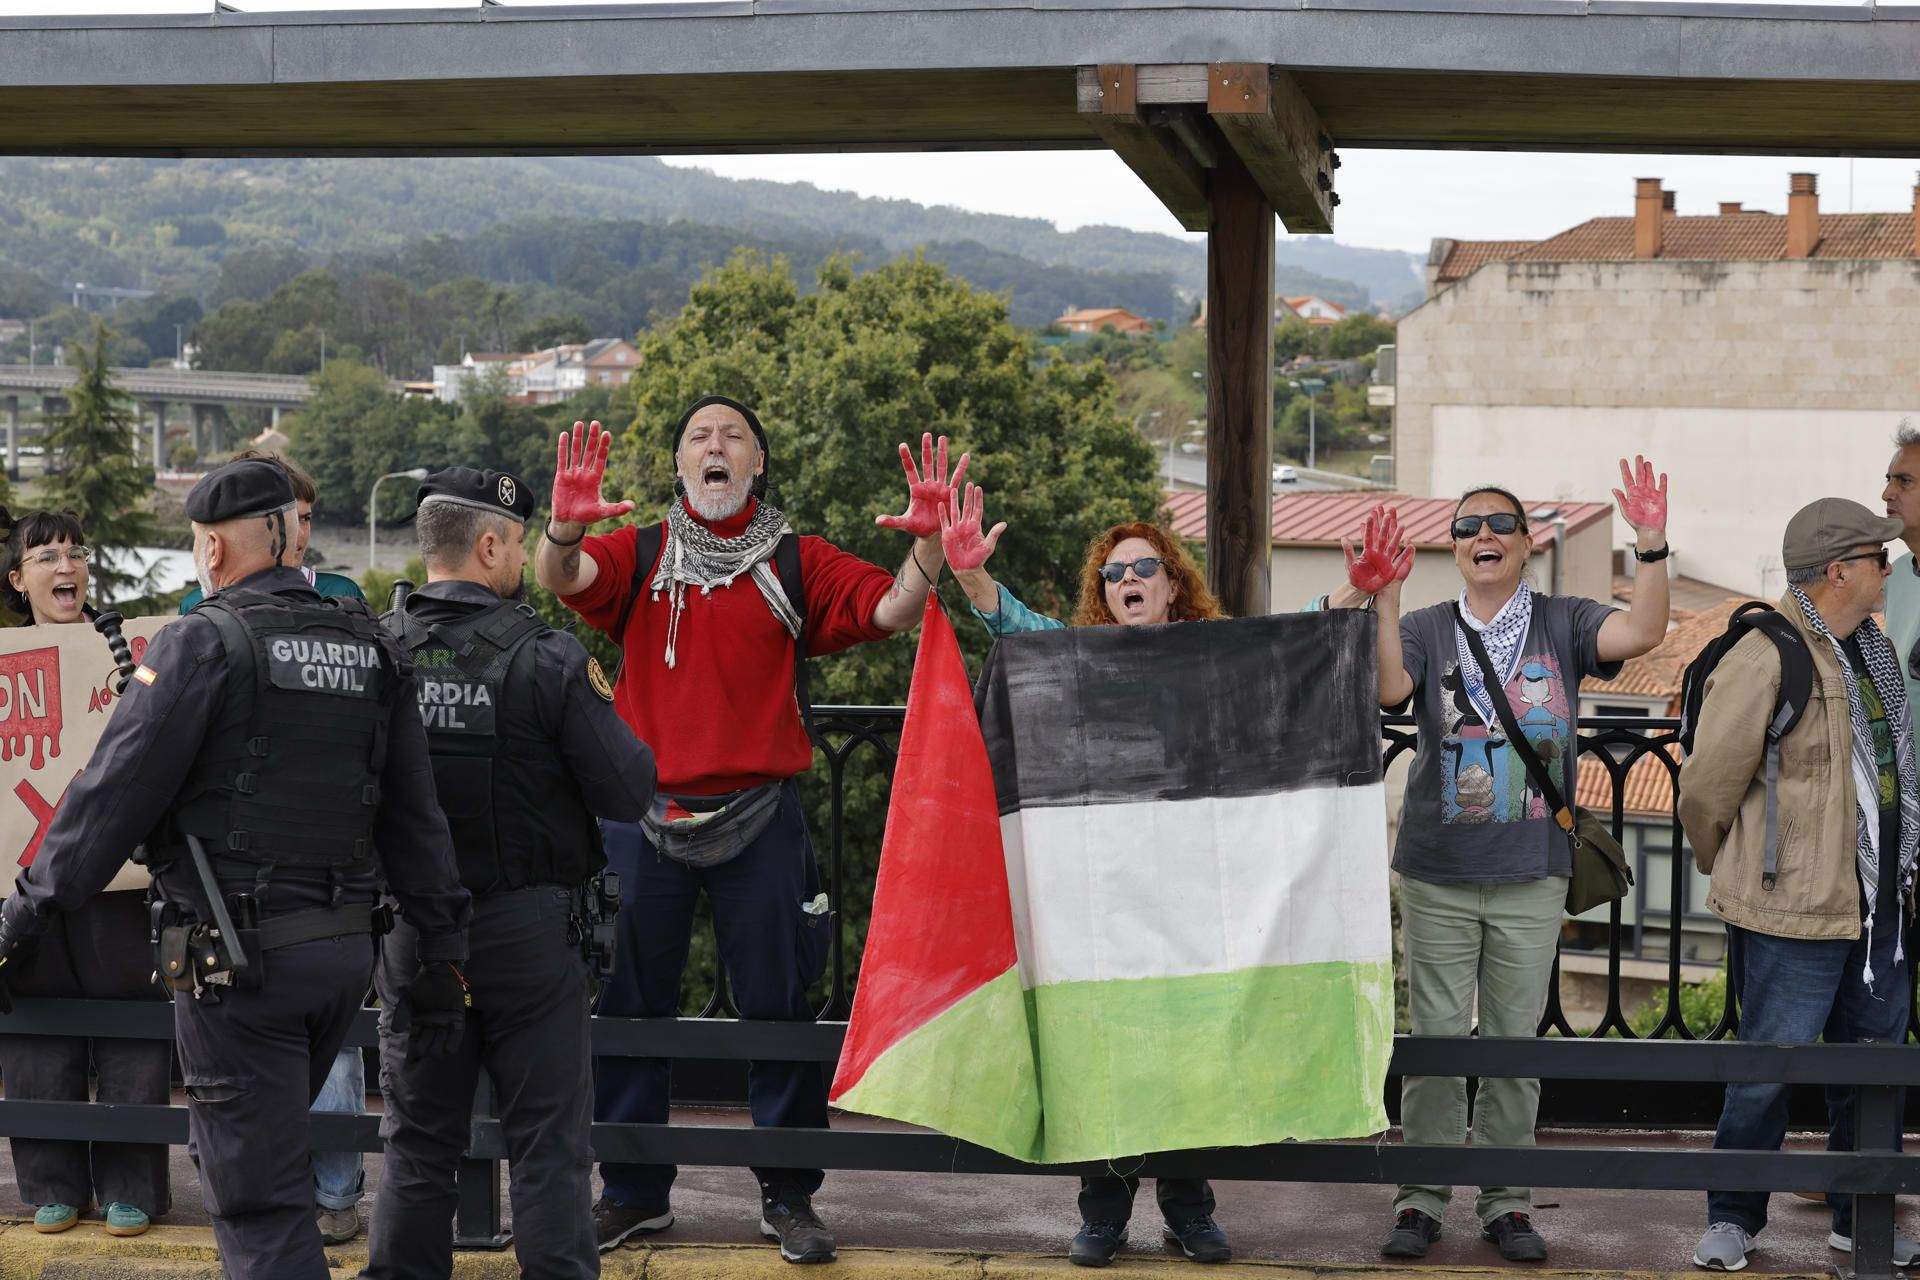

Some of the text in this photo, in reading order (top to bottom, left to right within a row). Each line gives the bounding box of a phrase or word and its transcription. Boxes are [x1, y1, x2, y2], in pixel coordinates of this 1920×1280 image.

[272, 639, 382, 670] GUARDIA
[301, 664, 364, 692] CIVIL
[416, 681, 492, 706] RDIA
[418, 704, 466, 729] VIL
